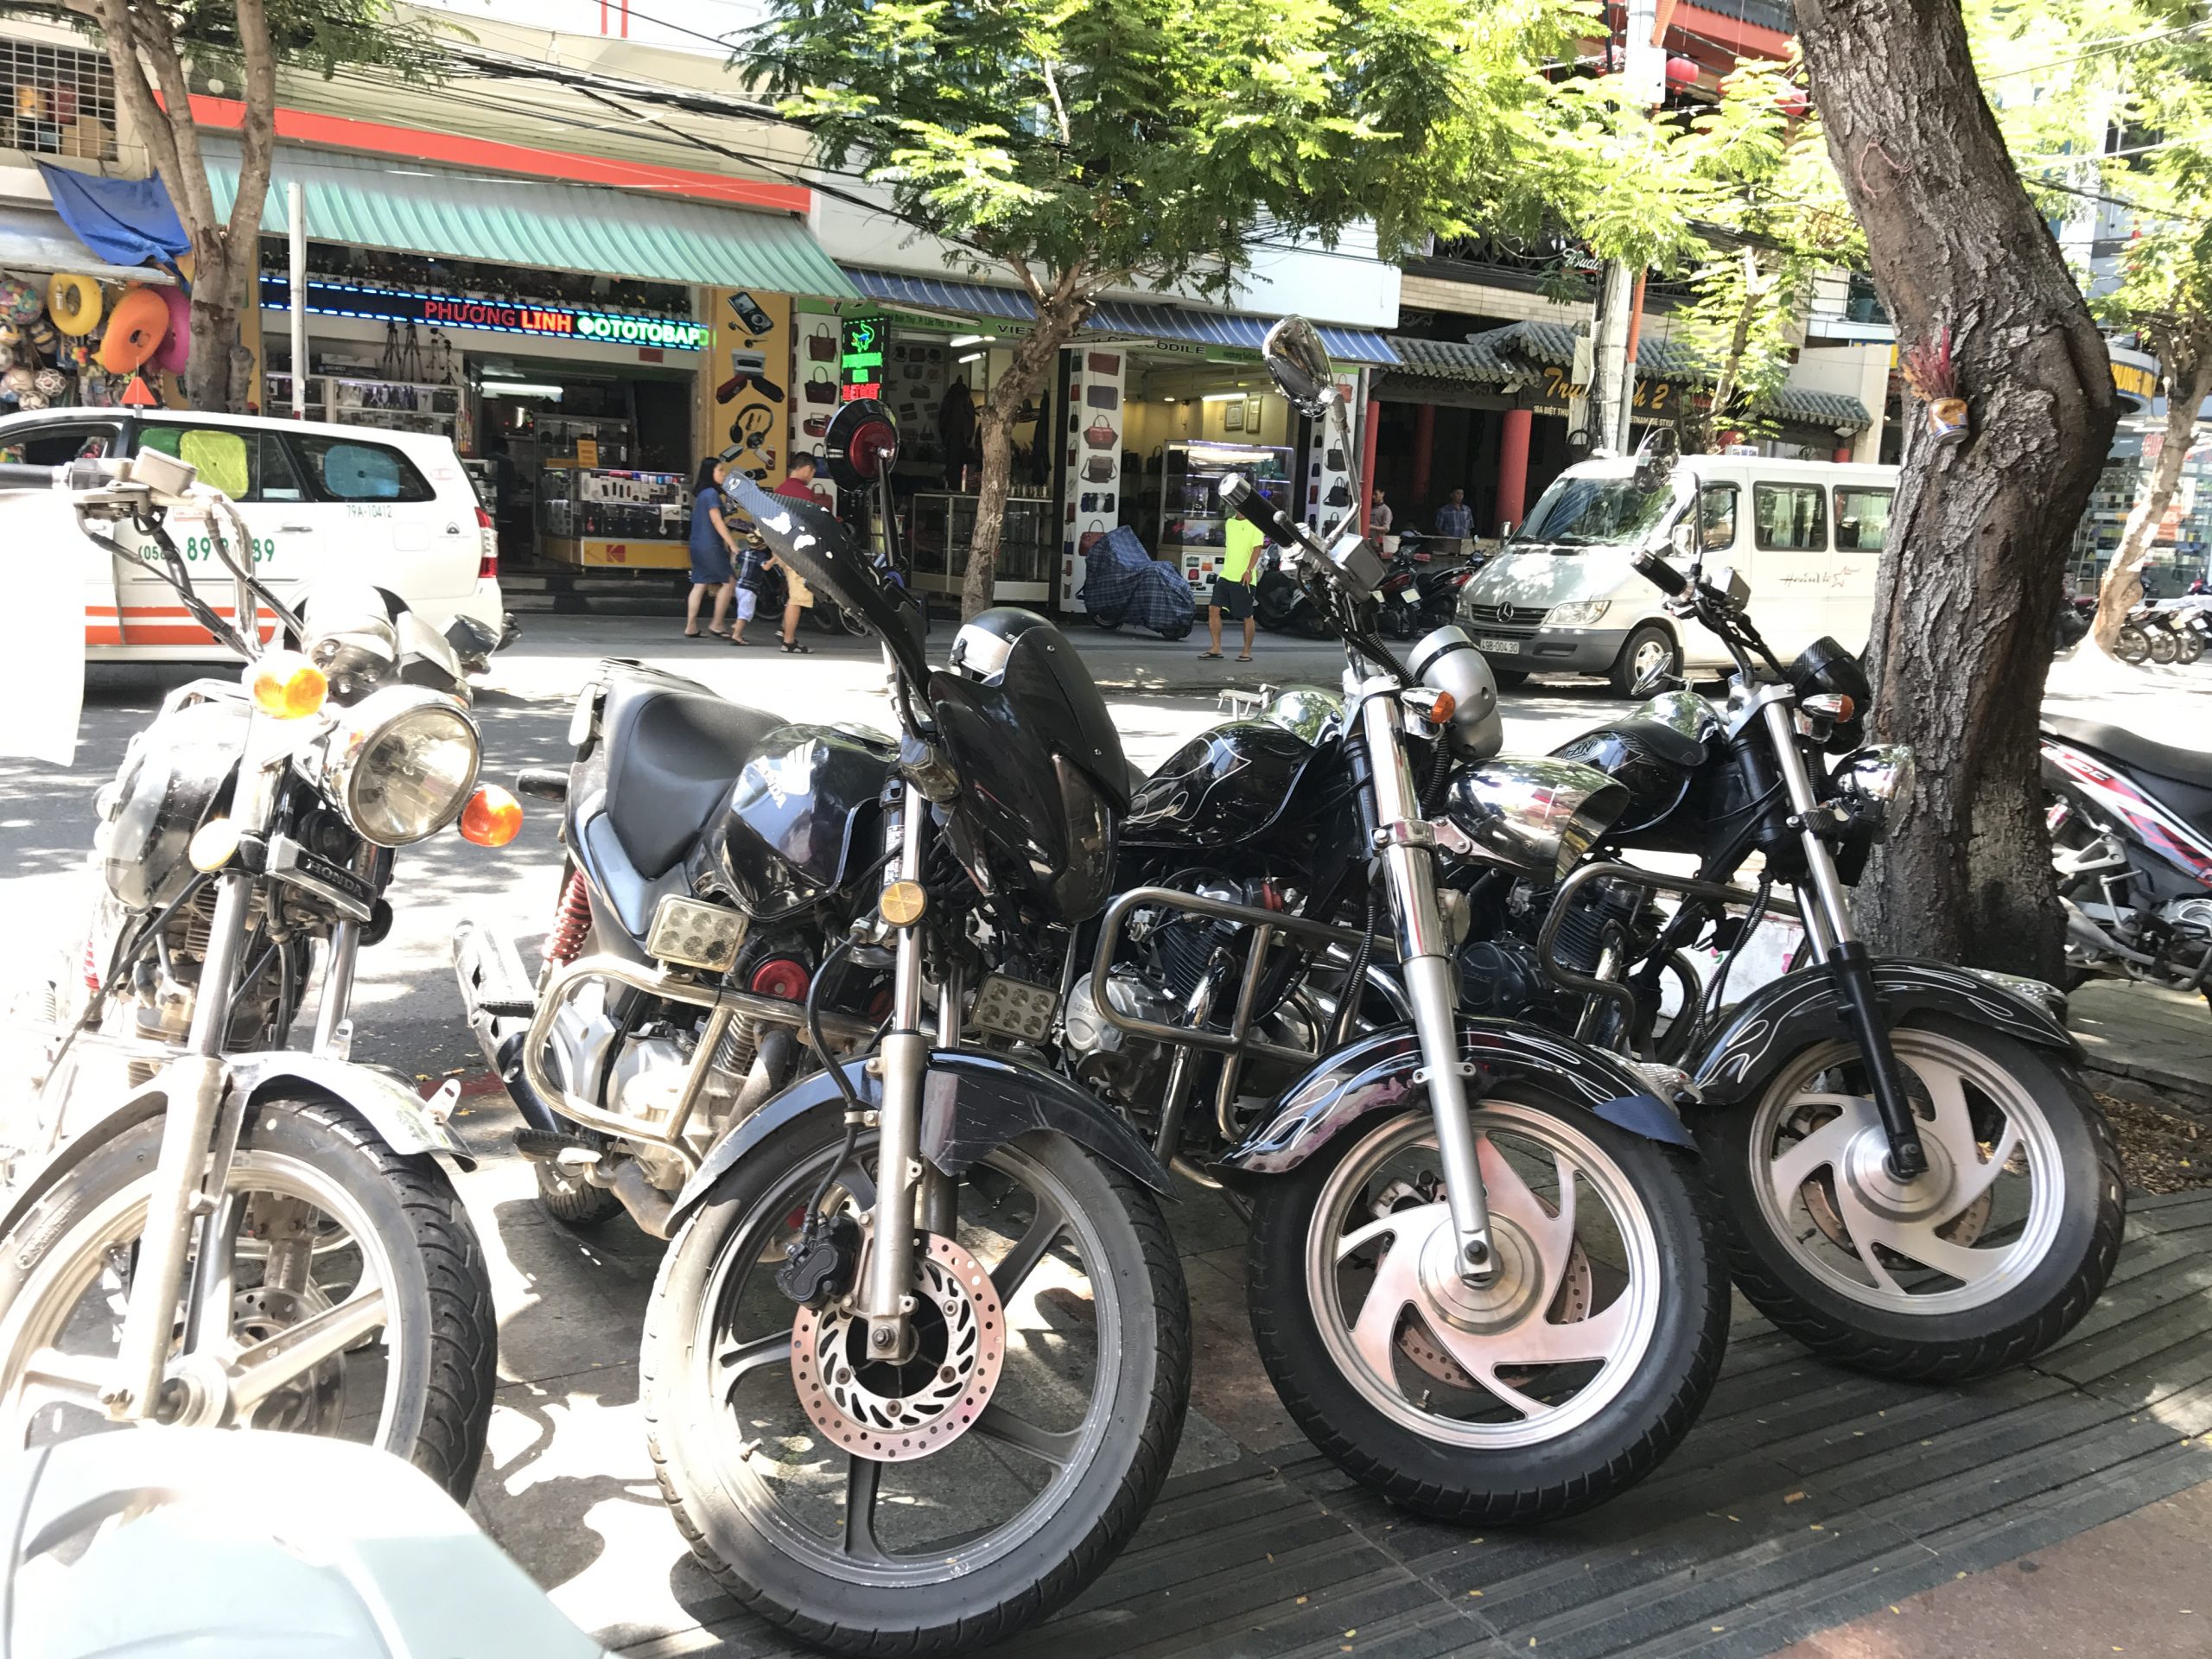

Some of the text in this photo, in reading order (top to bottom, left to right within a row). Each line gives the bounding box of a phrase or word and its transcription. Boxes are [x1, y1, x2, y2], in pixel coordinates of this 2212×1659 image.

[425, 300, 571, 334] PHƯƠNG LINH
[1650, 383, 1669, 410] 2
[305, 858, 365, 898] HONDA
